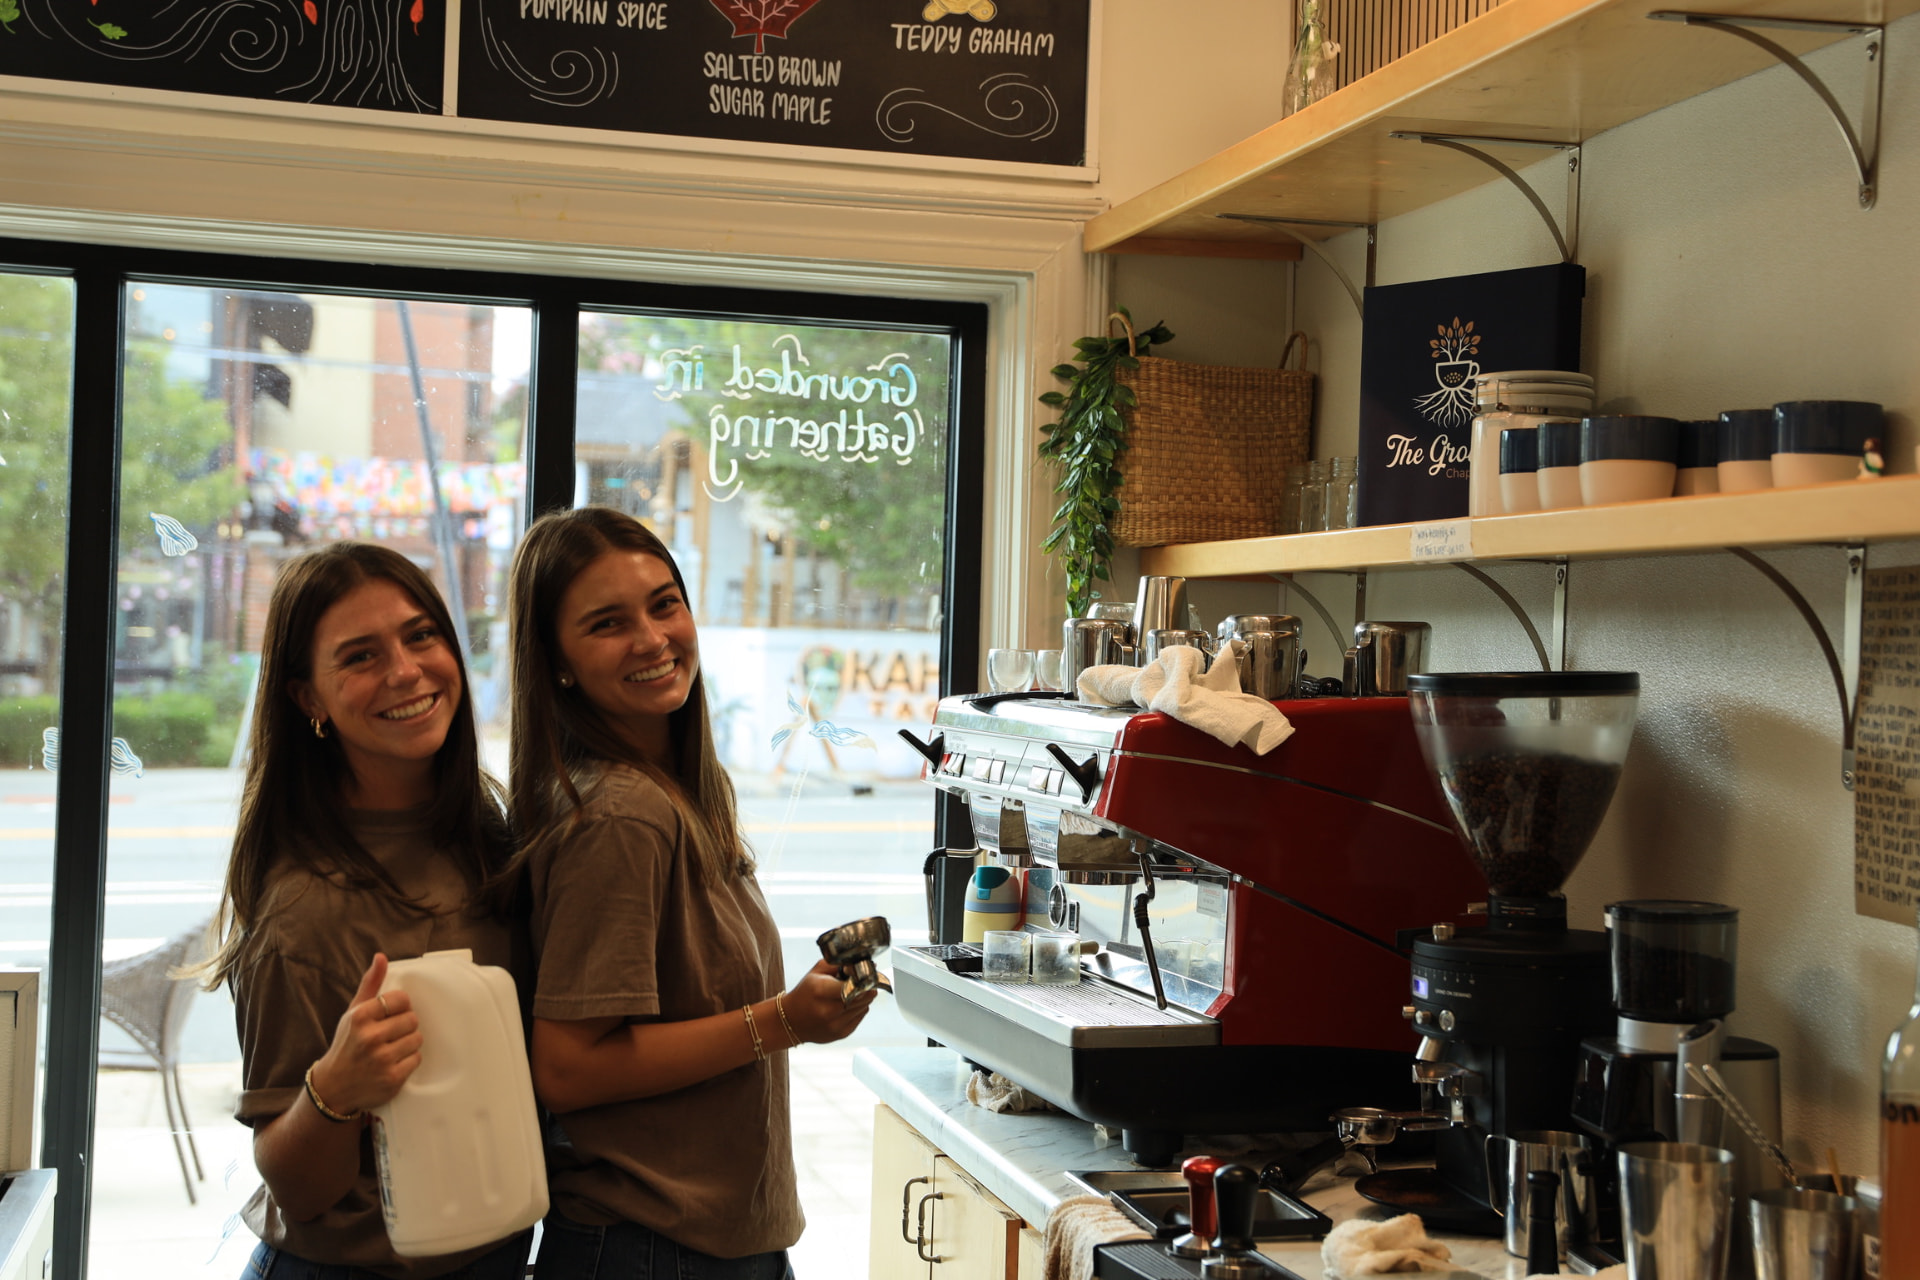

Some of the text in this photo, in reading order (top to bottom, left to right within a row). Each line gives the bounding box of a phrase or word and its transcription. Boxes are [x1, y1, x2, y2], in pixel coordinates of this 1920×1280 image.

[520, 0, 668, 30] PUMPKIN SPICE
[891, 24, 1054, 57] TEDDY GRAHAM
[703, 51, 842, 87] SALTED BROWN
[709, 84, 832, 125] SUGAR MAPLE
[1386, 434, 1472, 476] The Gro
